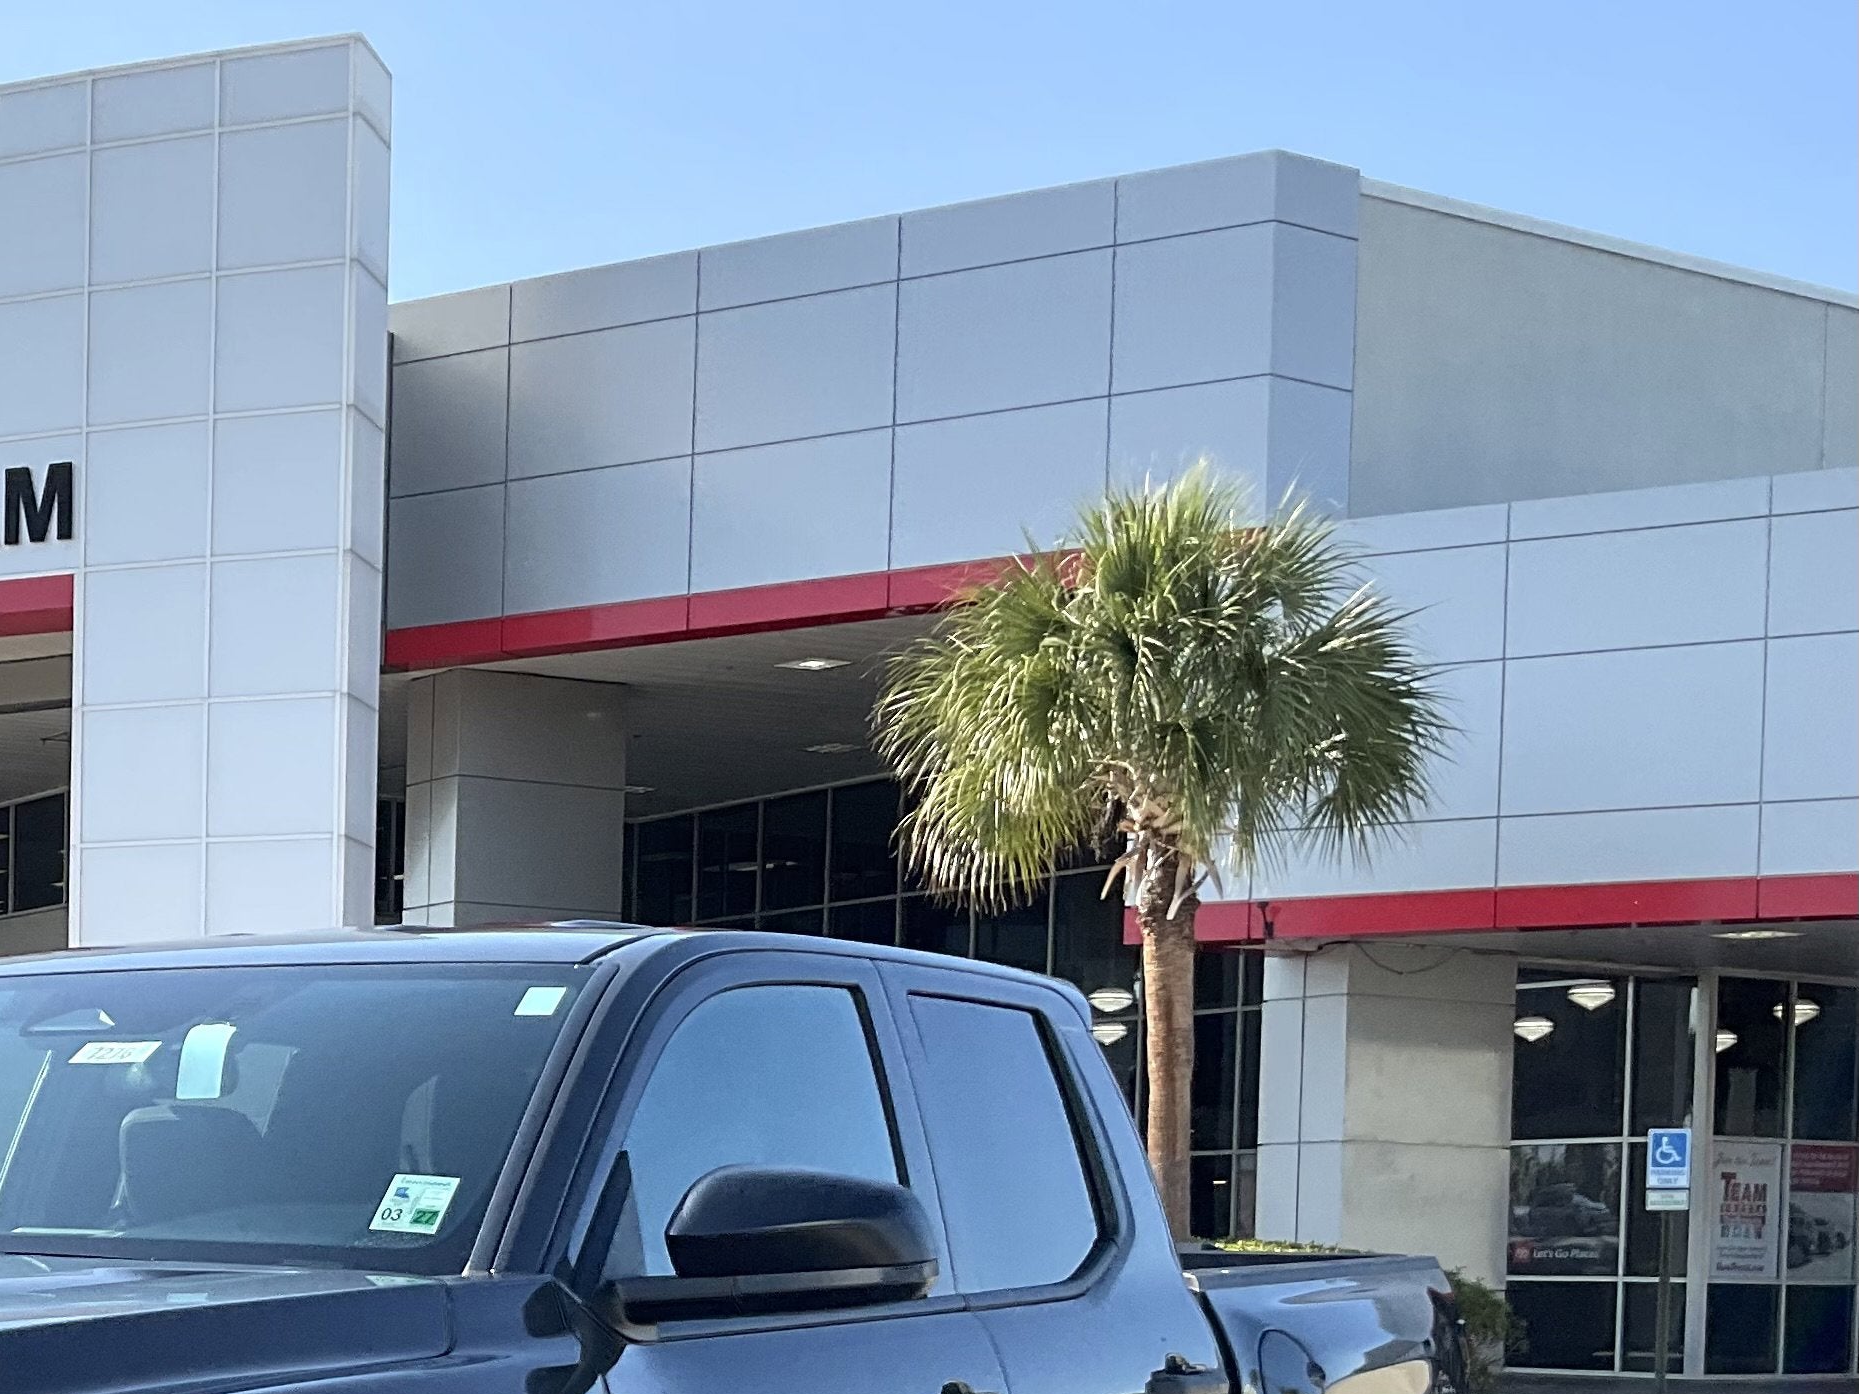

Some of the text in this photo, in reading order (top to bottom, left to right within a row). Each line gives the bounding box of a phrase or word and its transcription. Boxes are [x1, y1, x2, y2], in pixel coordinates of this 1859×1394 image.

[1720, 1171, 1767, 1201] TEAM
[381, 1207, 403, 1221] 03
[409, 1210, 441, 1226] 27
[1555, 1248, 1569, 1258] Go
